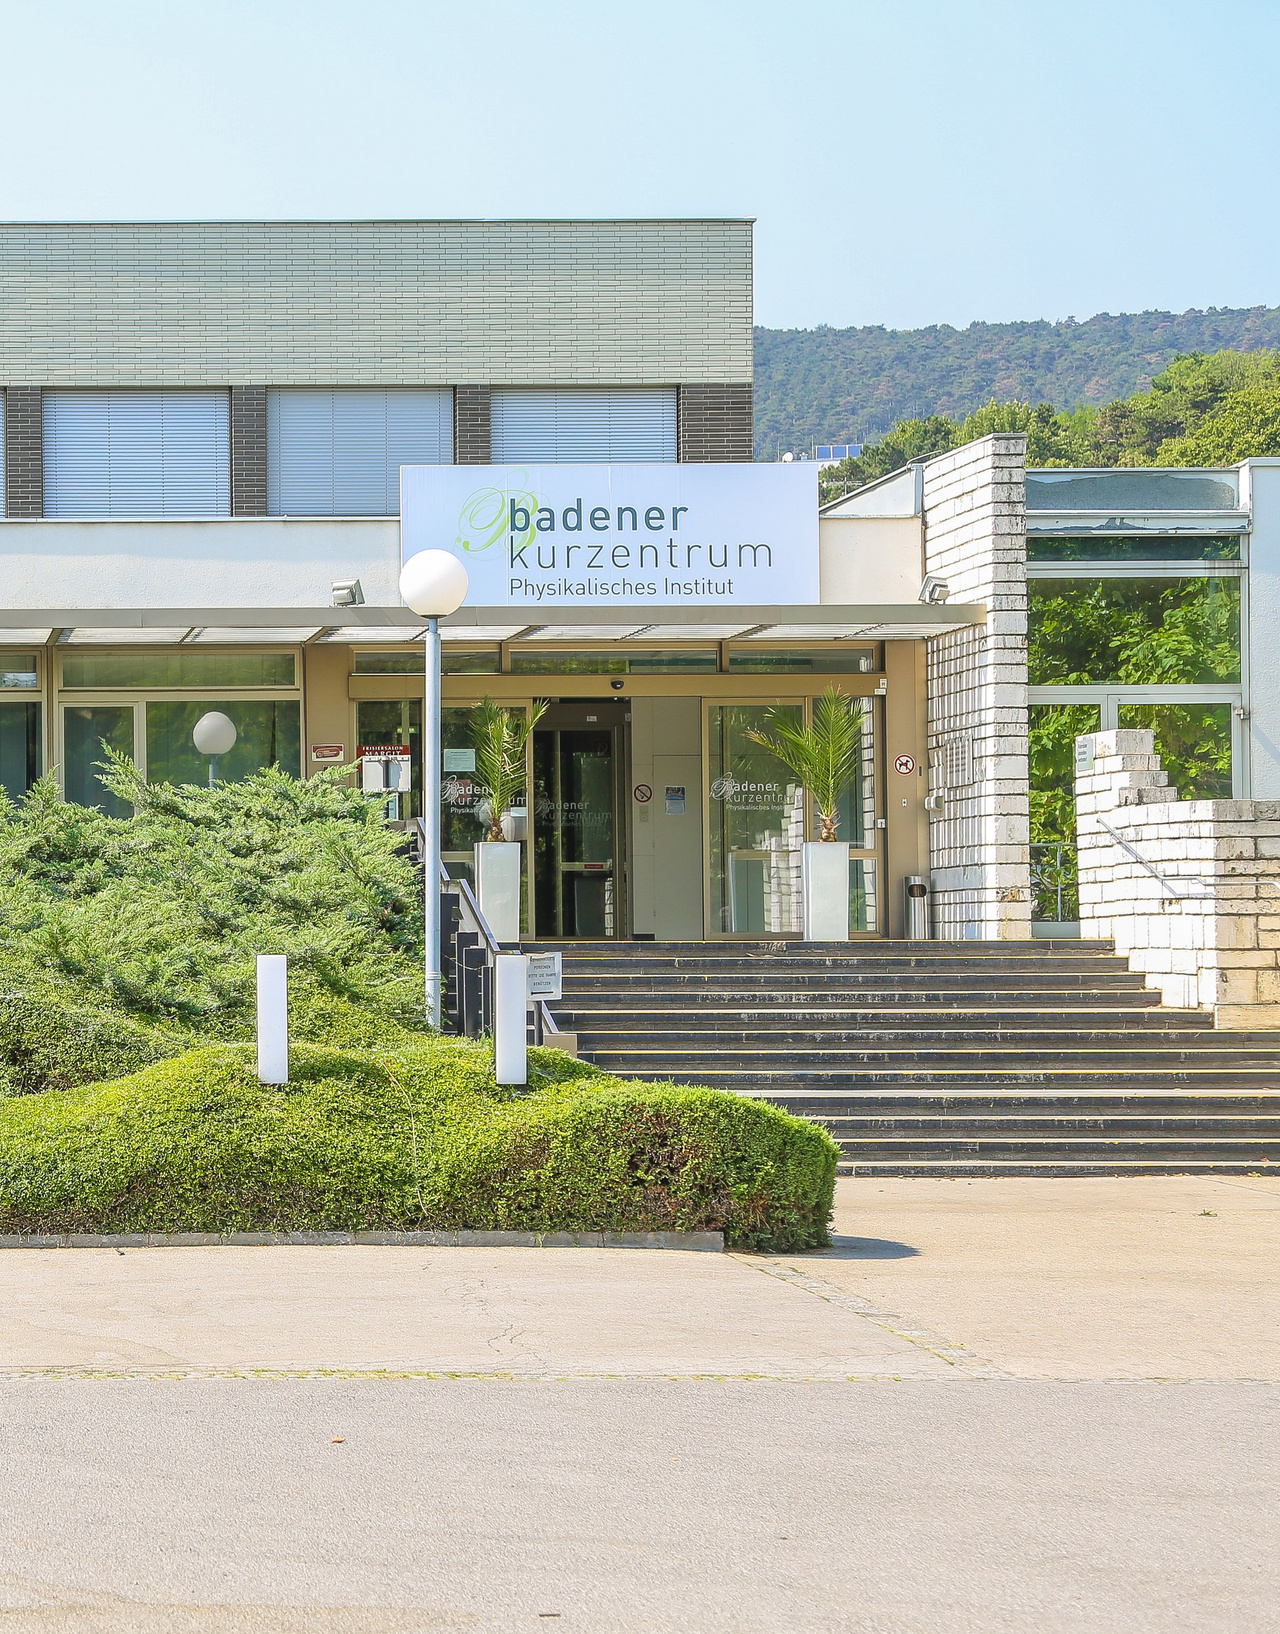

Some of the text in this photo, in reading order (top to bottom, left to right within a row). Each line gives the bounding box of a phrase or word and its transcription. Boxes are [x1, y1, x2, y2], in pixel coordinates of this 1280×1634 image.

[510, 497, 689, 532] badener
[510, 535, 773, 569] kurzentrum
[510, 577, 734, 600] Physikalisches Institut
